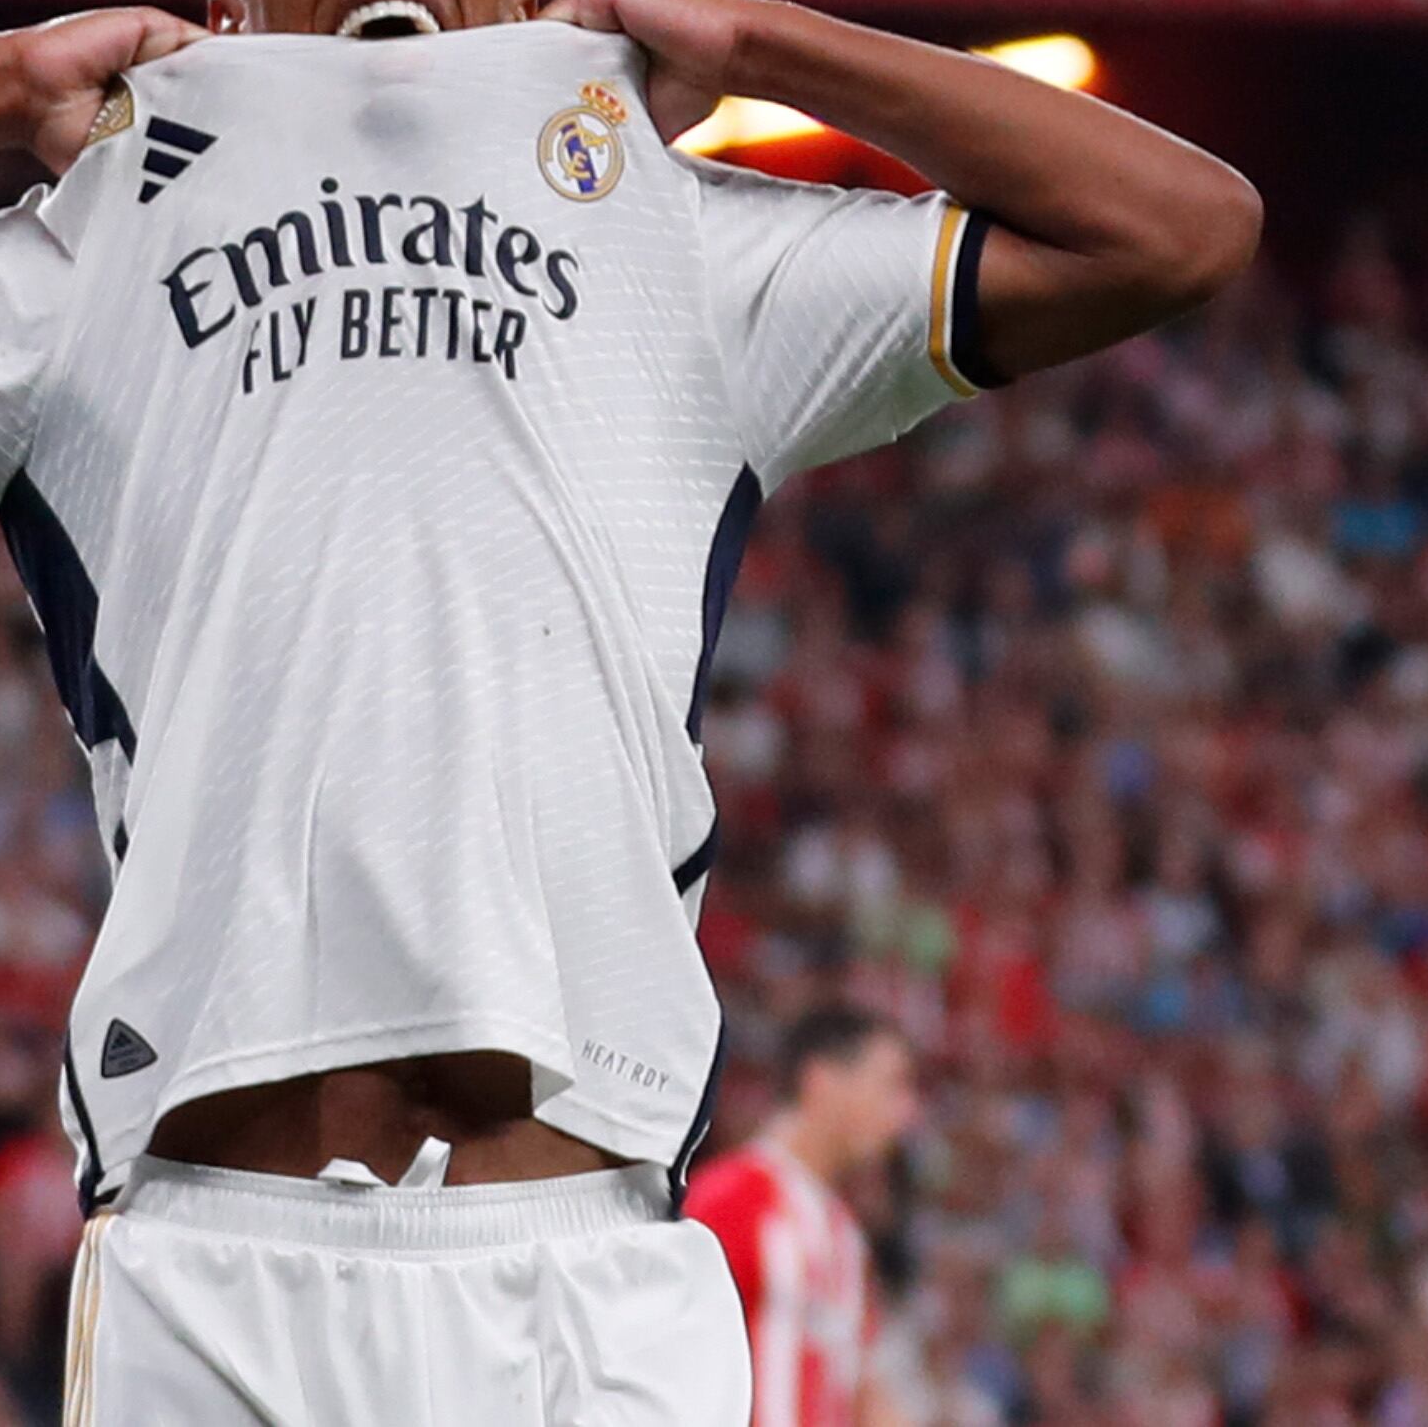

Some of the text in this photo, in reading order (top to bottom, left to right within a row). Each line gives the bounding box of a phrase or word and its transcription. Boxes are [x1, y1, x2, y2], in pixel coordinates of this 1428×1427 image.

[161, 178, 580, 349] Emirates
[242, 287, 528, 394] FLY BETTER
